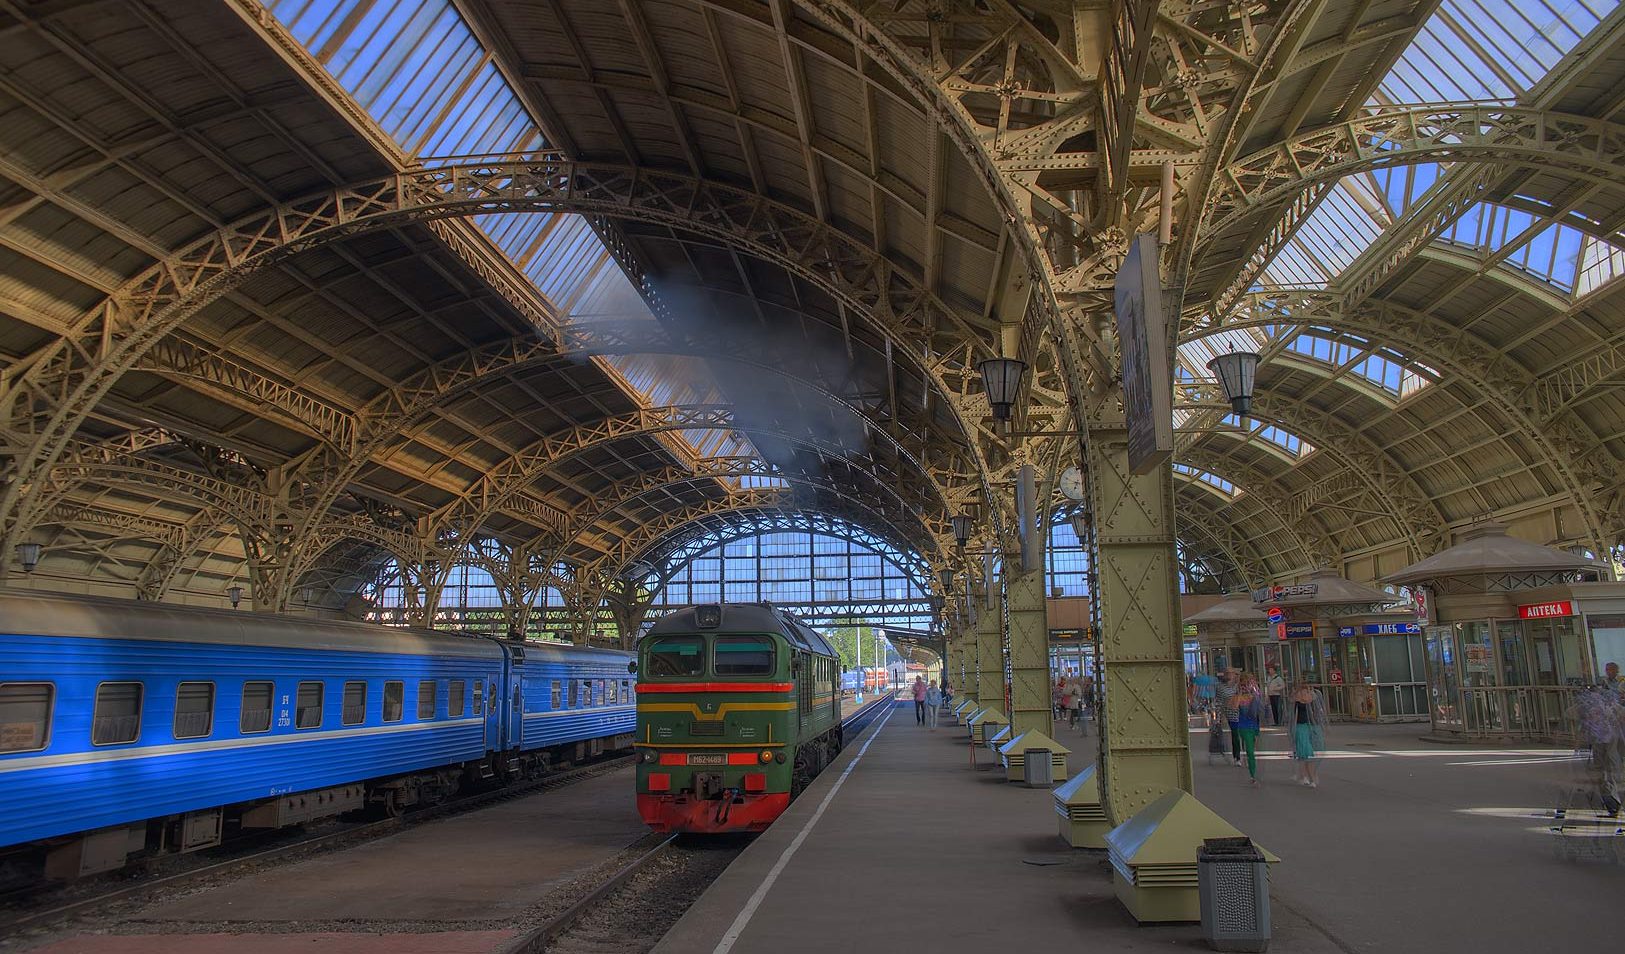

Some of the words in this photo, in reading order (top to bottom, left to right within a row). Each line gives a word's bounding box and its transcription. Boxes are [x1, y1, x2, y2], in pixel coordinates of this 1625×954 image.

[1284, 585, 1318, 596] PEPSI
[1527, 604, 1563, 617] АПТЕКА
[1378, 623, 1398, 635] ХЛЕБ
